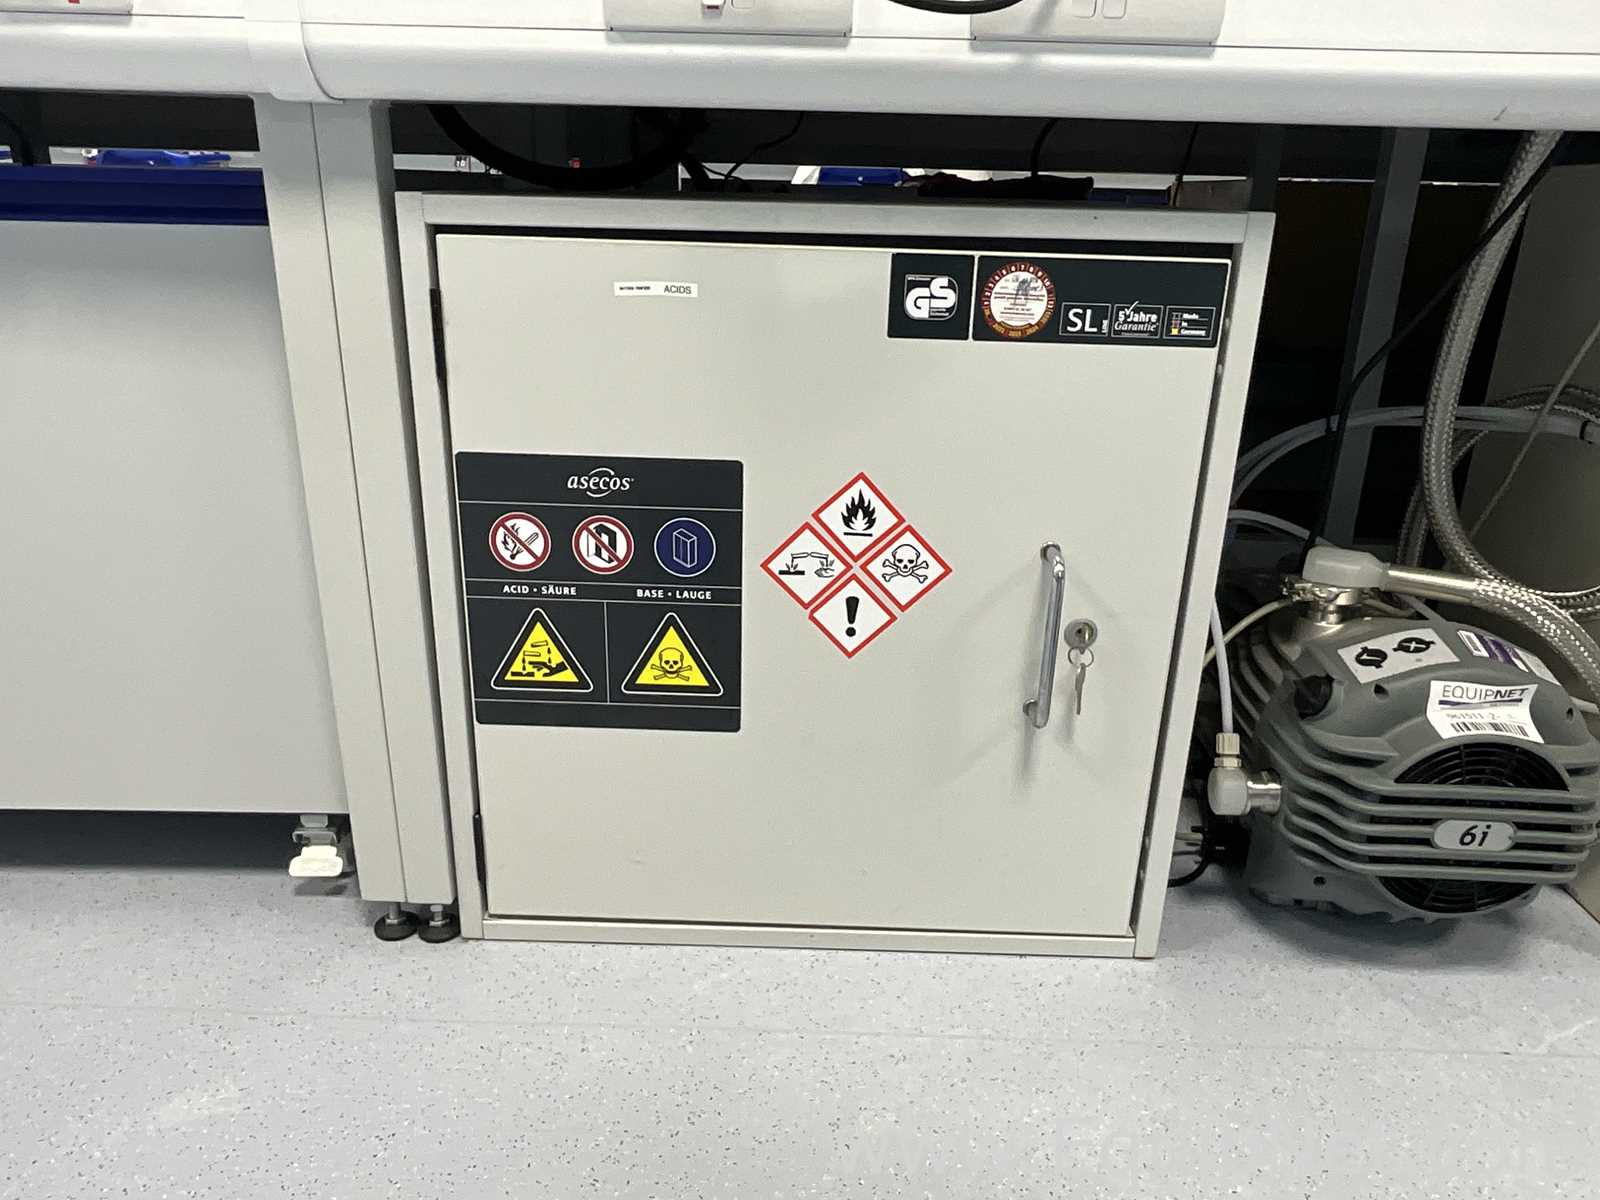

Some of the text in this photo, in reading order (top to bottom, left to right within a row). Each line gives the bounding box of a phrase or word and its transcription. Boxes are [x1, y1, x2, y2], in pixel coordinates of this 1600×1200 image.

[663, 285, 692, 295] ACIDS
[905, 277, 957, 319] GS
[1067, 308, 1098, 332] SL
[1118, 310, 1158, 323] 5 Jahre
[1114, 320, 1156, 332] Garantie
[567, 474, 631, 491] asecos
[503, 584, 577, 596] ACID SÄURE
[636, 588, 712, 600] BASE LAUGE
[1441, 685, 1529, 701] EQUIPNET
[1459, 824, 1492, 847] 6i
